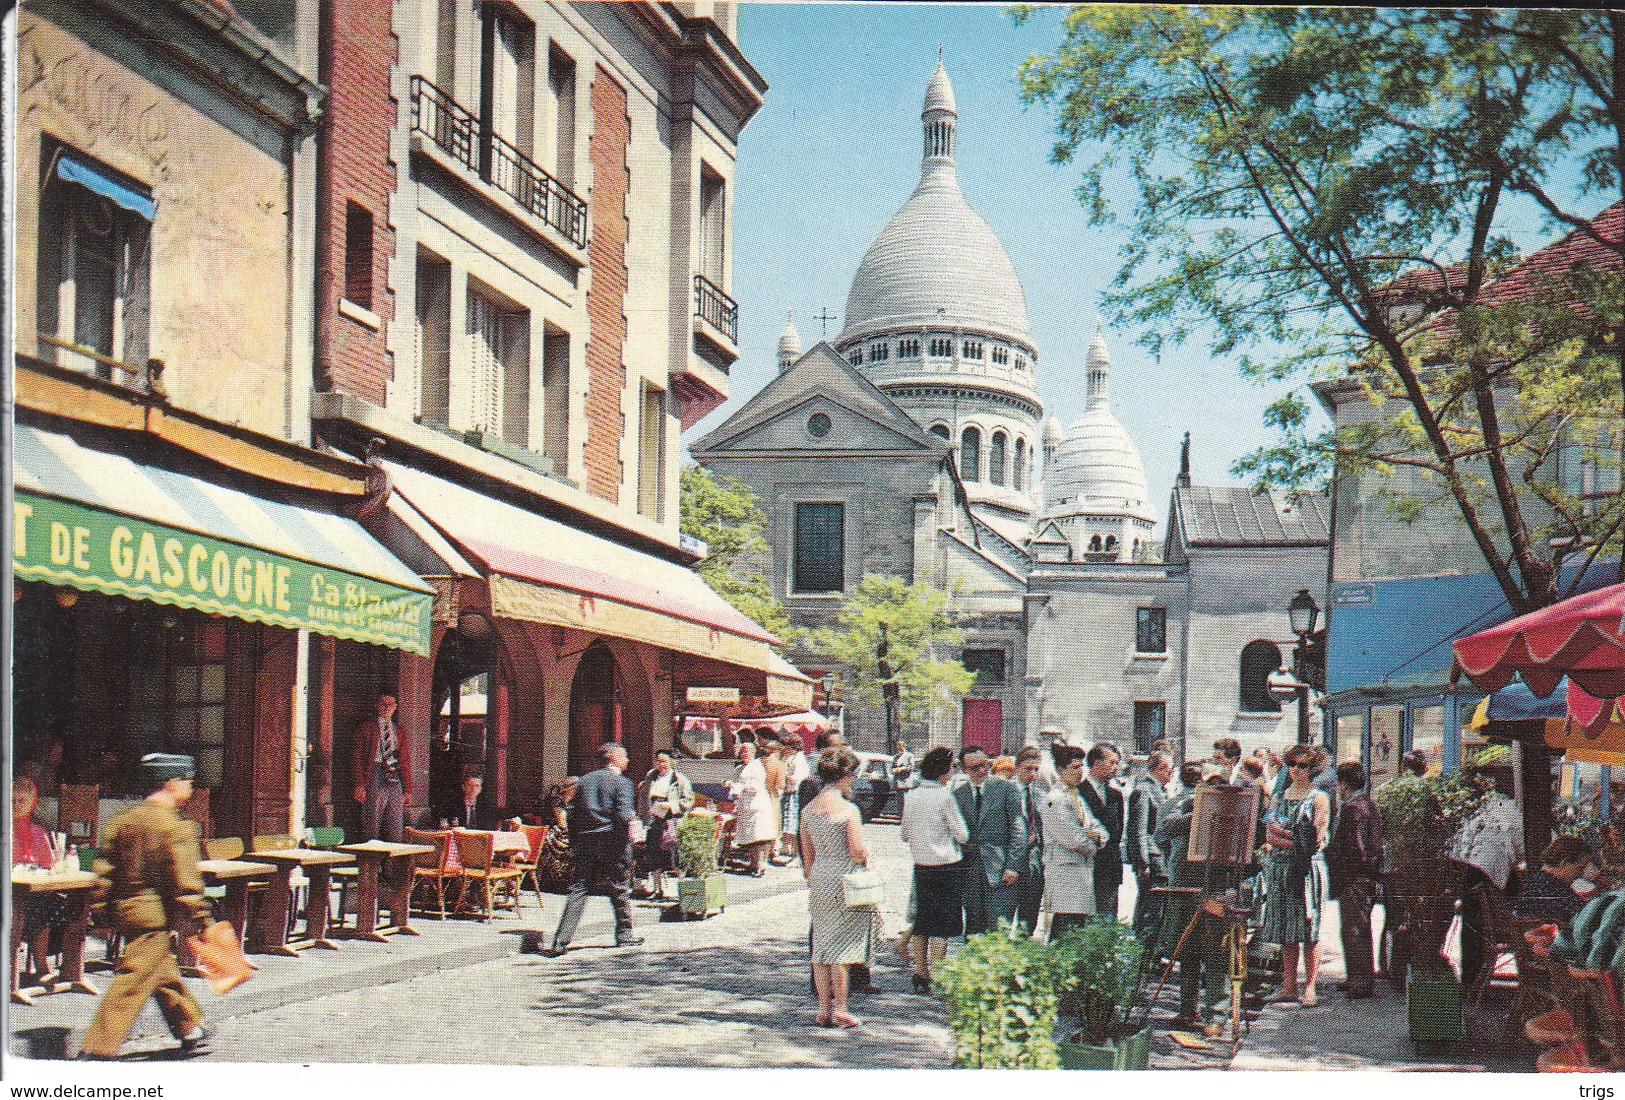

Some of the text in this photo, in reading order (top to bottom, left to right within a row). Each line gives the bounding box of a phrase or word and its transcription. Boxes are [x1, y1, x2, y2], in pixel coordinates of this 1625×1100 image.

[51, 522, 90, 570] DE
[110, 525, 291, 612] GASCOGNE
[311, 573, 340, 607] La
